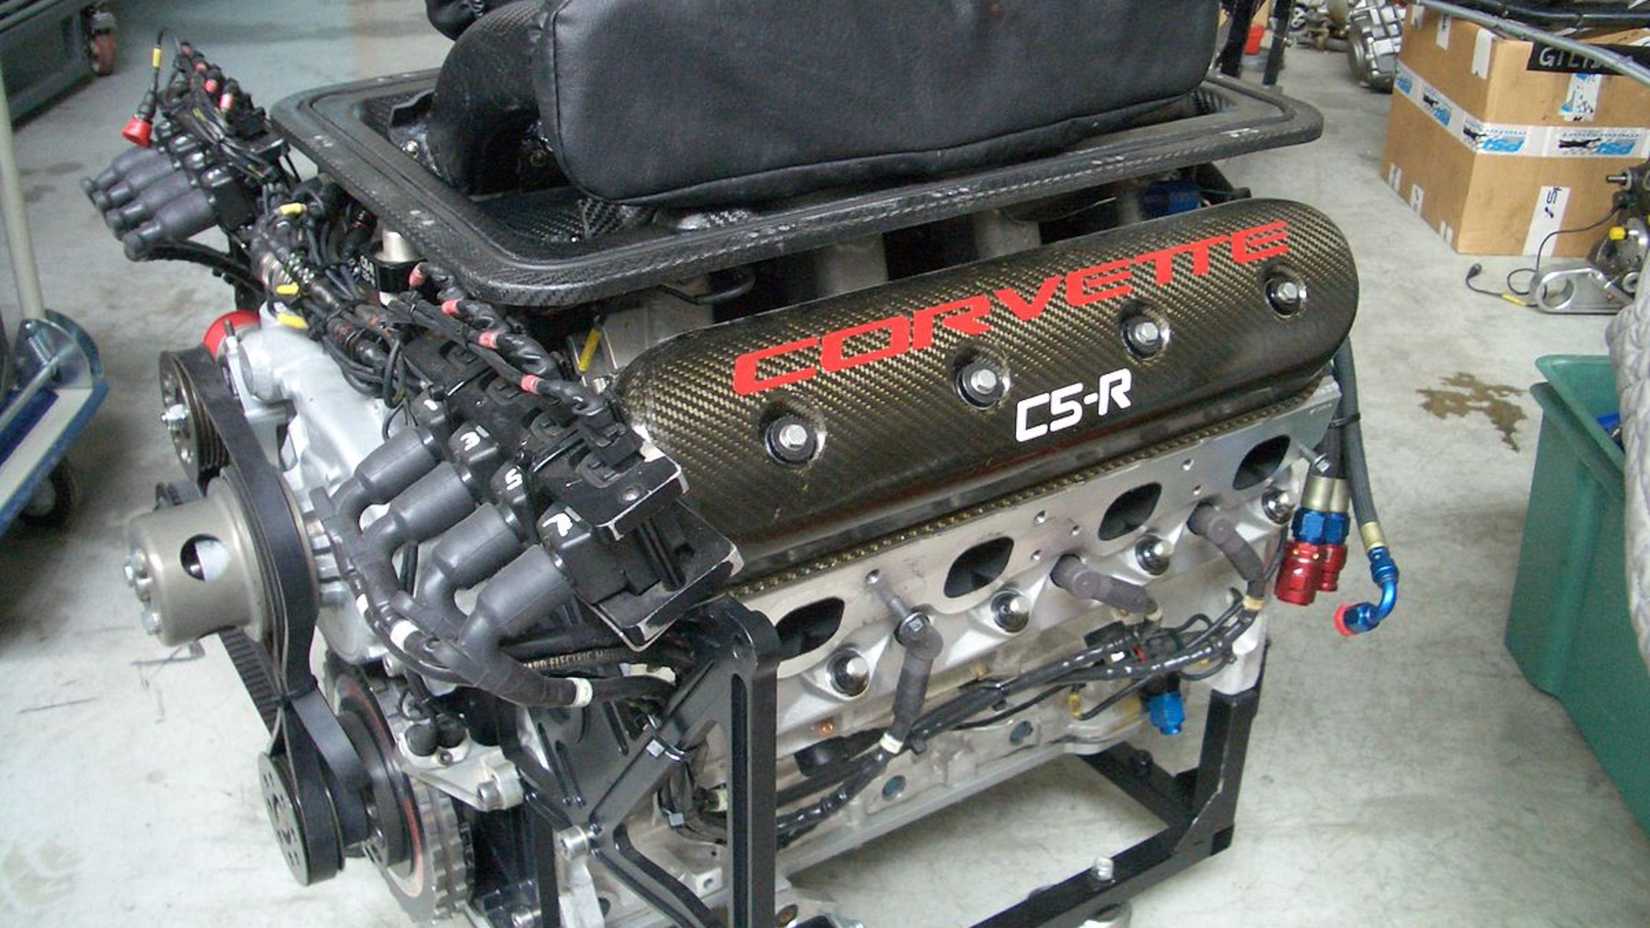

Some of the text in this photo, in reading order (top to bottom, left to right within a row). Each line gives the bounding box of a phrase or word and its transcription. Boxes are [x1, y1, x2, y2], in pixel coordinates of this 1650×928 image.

[733, 222, 1288, 395] CORVETTE
[1016, 368, 1132, 442] C5-R
[460, 431, 481, 452] 3
[504, 467, 523, 491] 5
[541, 512, 573, 537] 7
